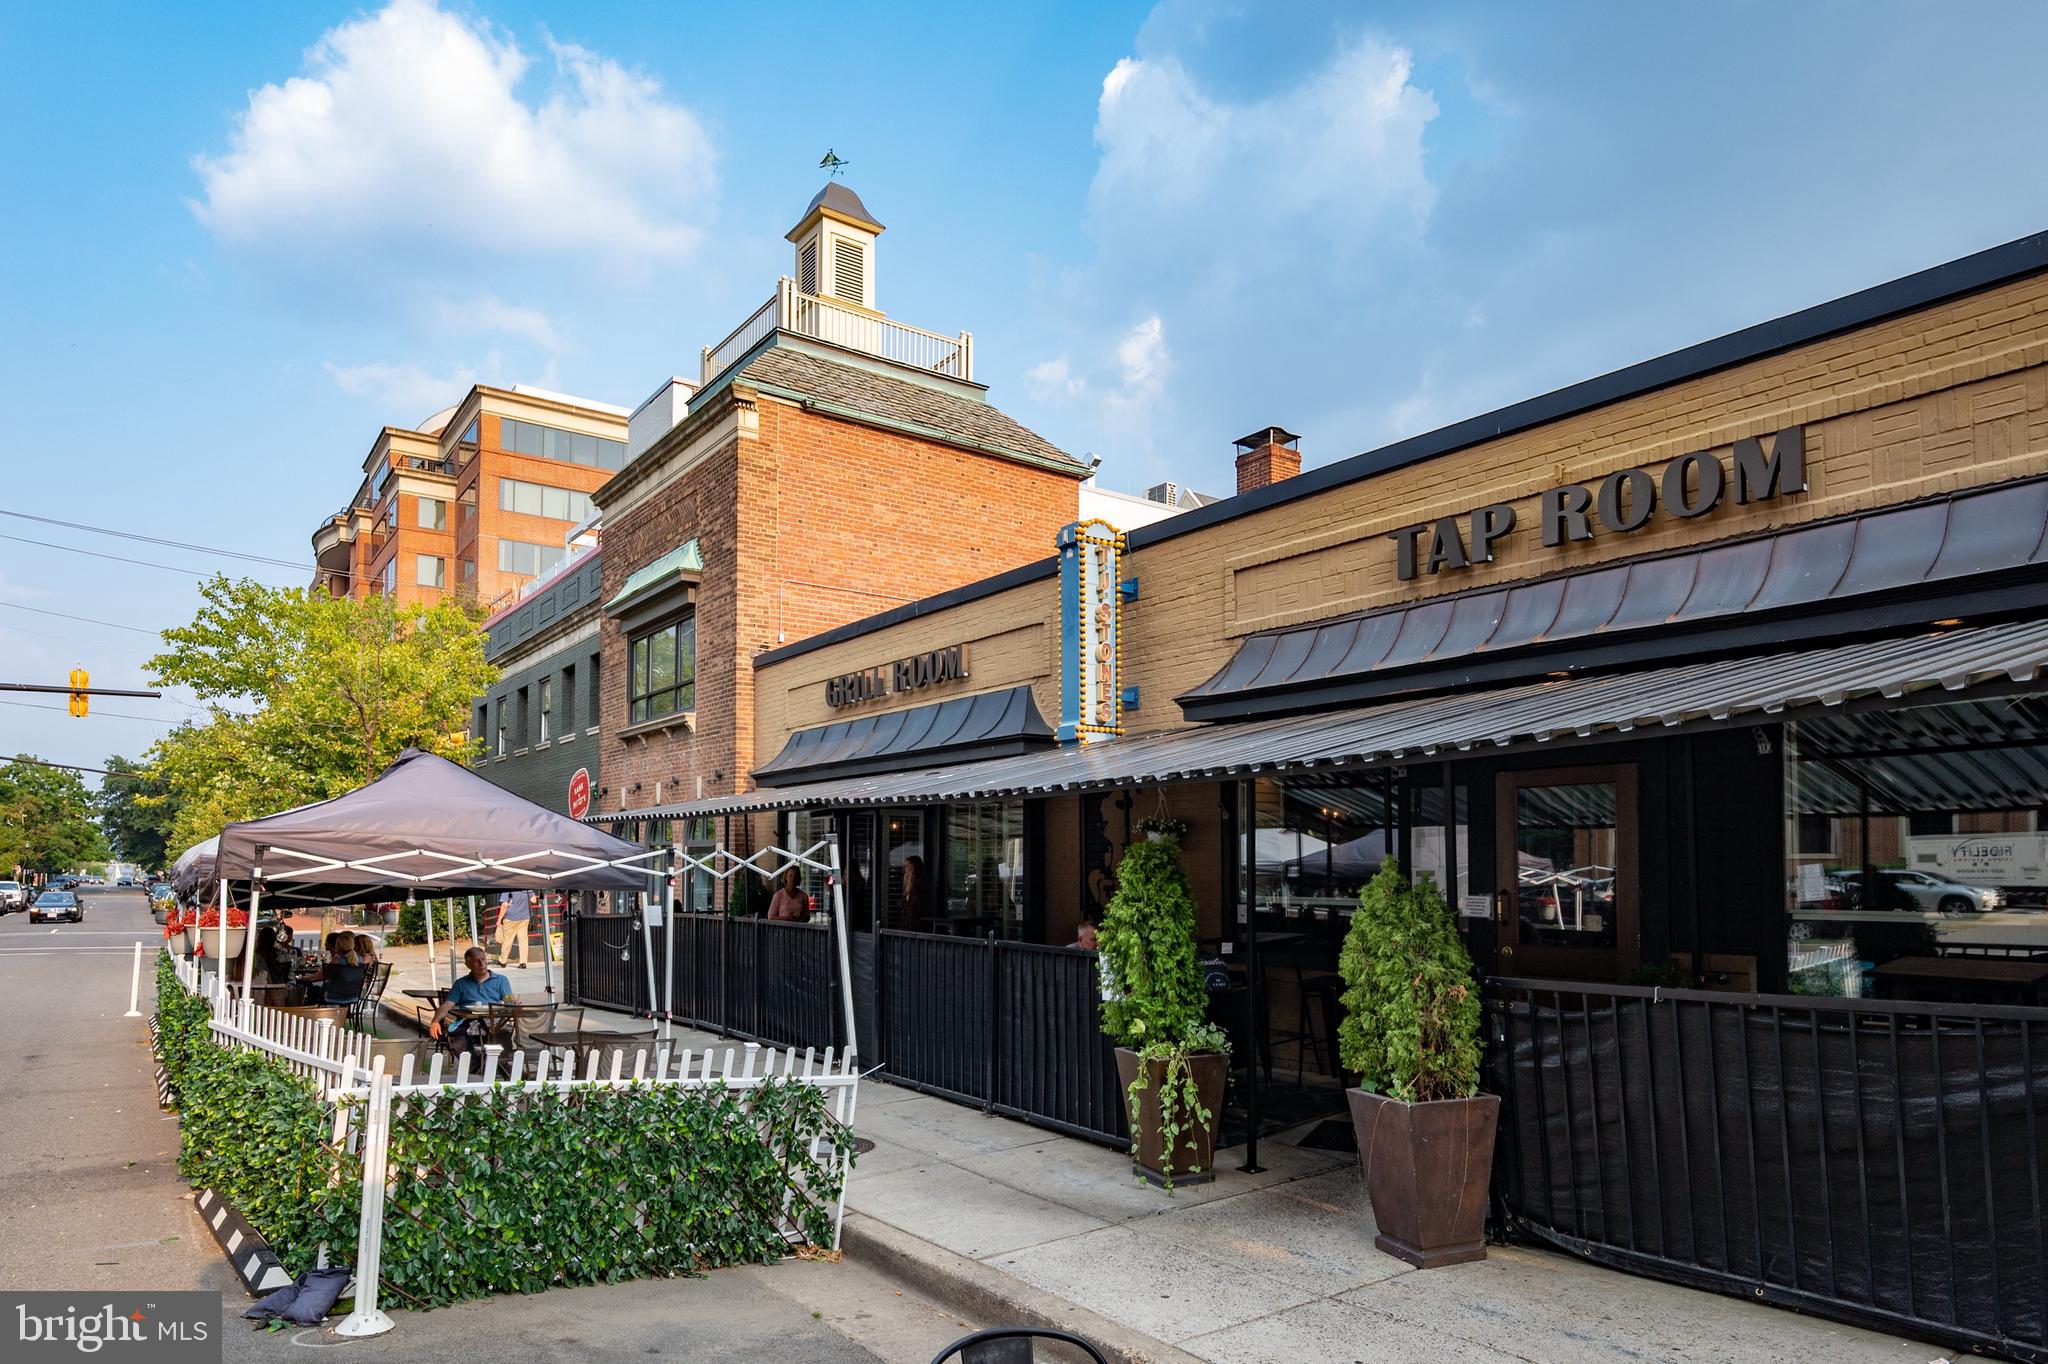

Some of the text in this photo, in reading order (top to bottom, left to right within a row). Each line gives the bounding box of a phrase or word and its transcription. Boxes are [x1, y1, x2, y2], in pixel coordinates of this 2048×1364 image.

[1387, 426, 1809, 581] TAP ROOM
[825, 643, 969, 708] GRILL ROOM
